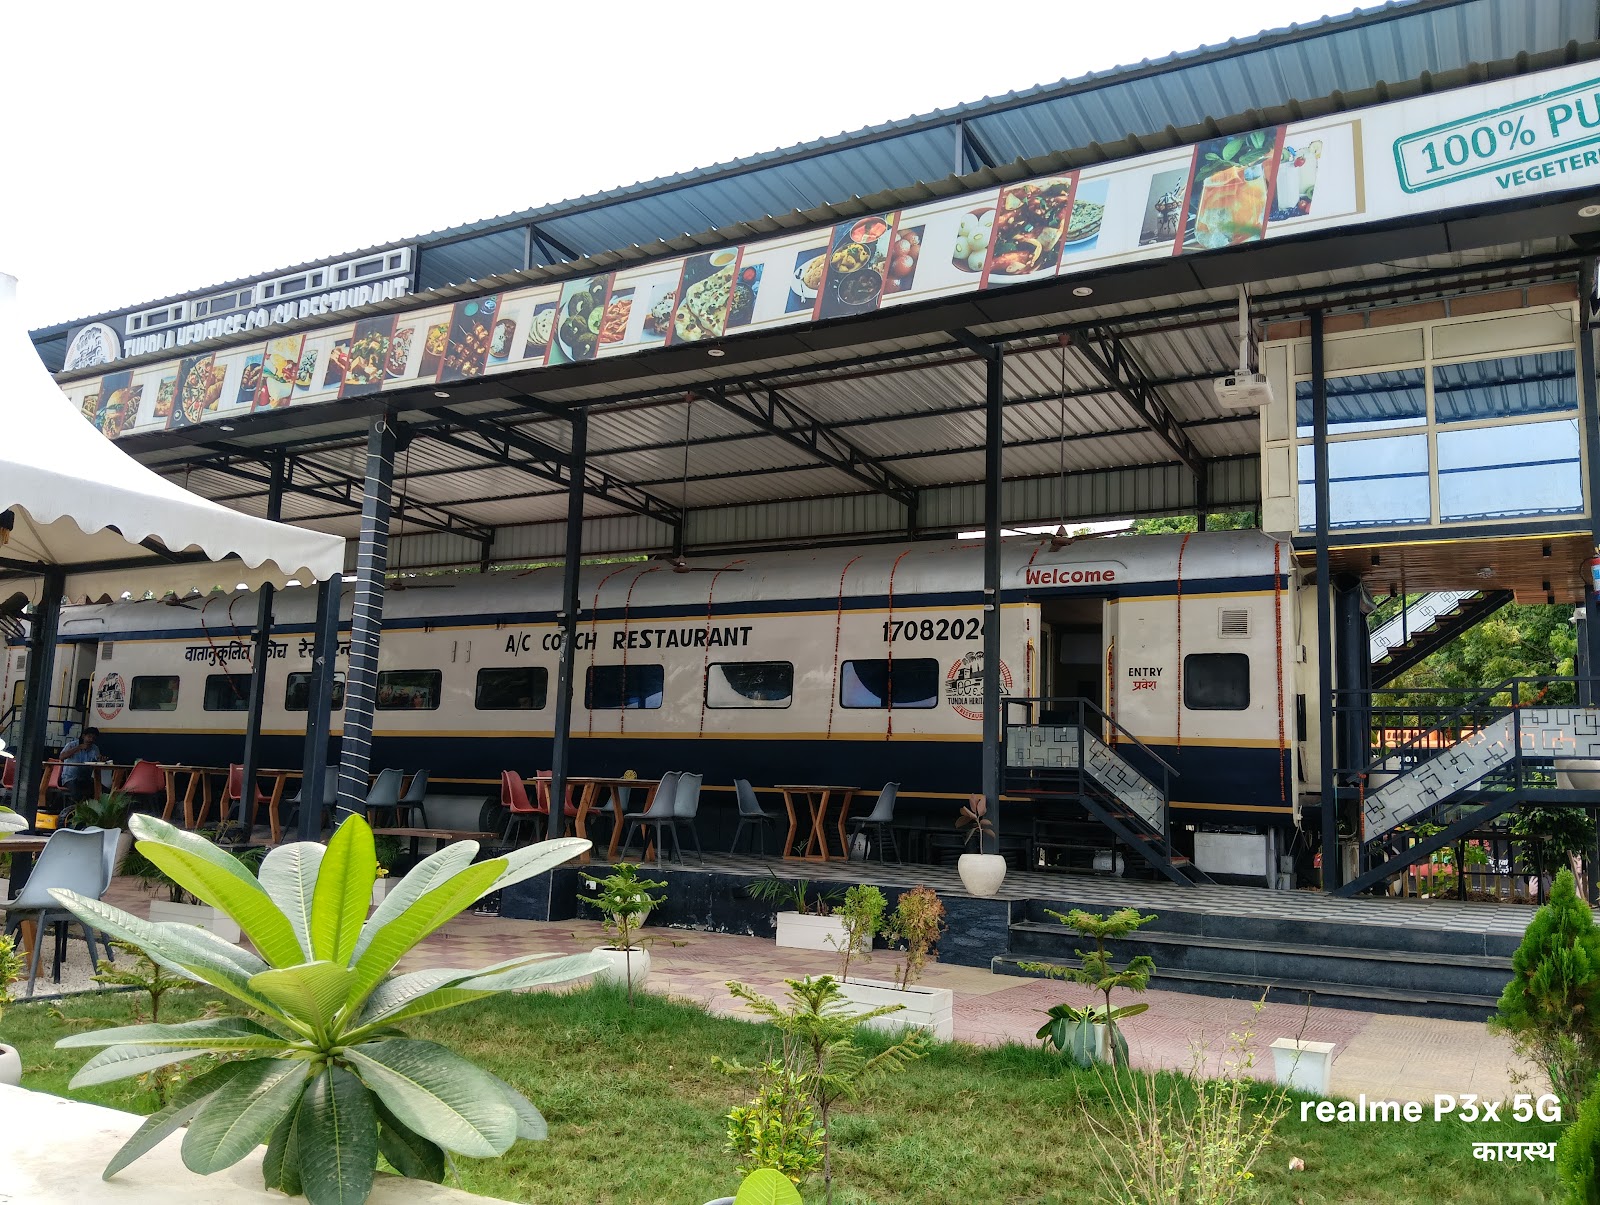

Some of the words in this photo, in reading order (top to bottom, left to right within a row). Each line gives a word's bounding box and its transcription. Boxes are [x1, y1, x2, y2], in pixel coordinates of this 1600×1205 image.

[1421, 115, 1536, 174] 100%
[1026, 568, 1115, 585] Welcome
[882, 617, 985, 642] 1708202
[505, 631, 531, 657] A/C
[542, 632, 598, 651] COCH
[612, 626, 753, 650] RESTAURANT
[185, 640, 252, 666] वातानुकूलित
[1128, 667, 1163, 677] ENTRY
[1132, 678, 1158, 691] प्रवेश
[947, 697, 968, 705] TUNDLA
[969, 697, 984, 705] HERIT
[959, 707, 984, 719] RESTAUR
